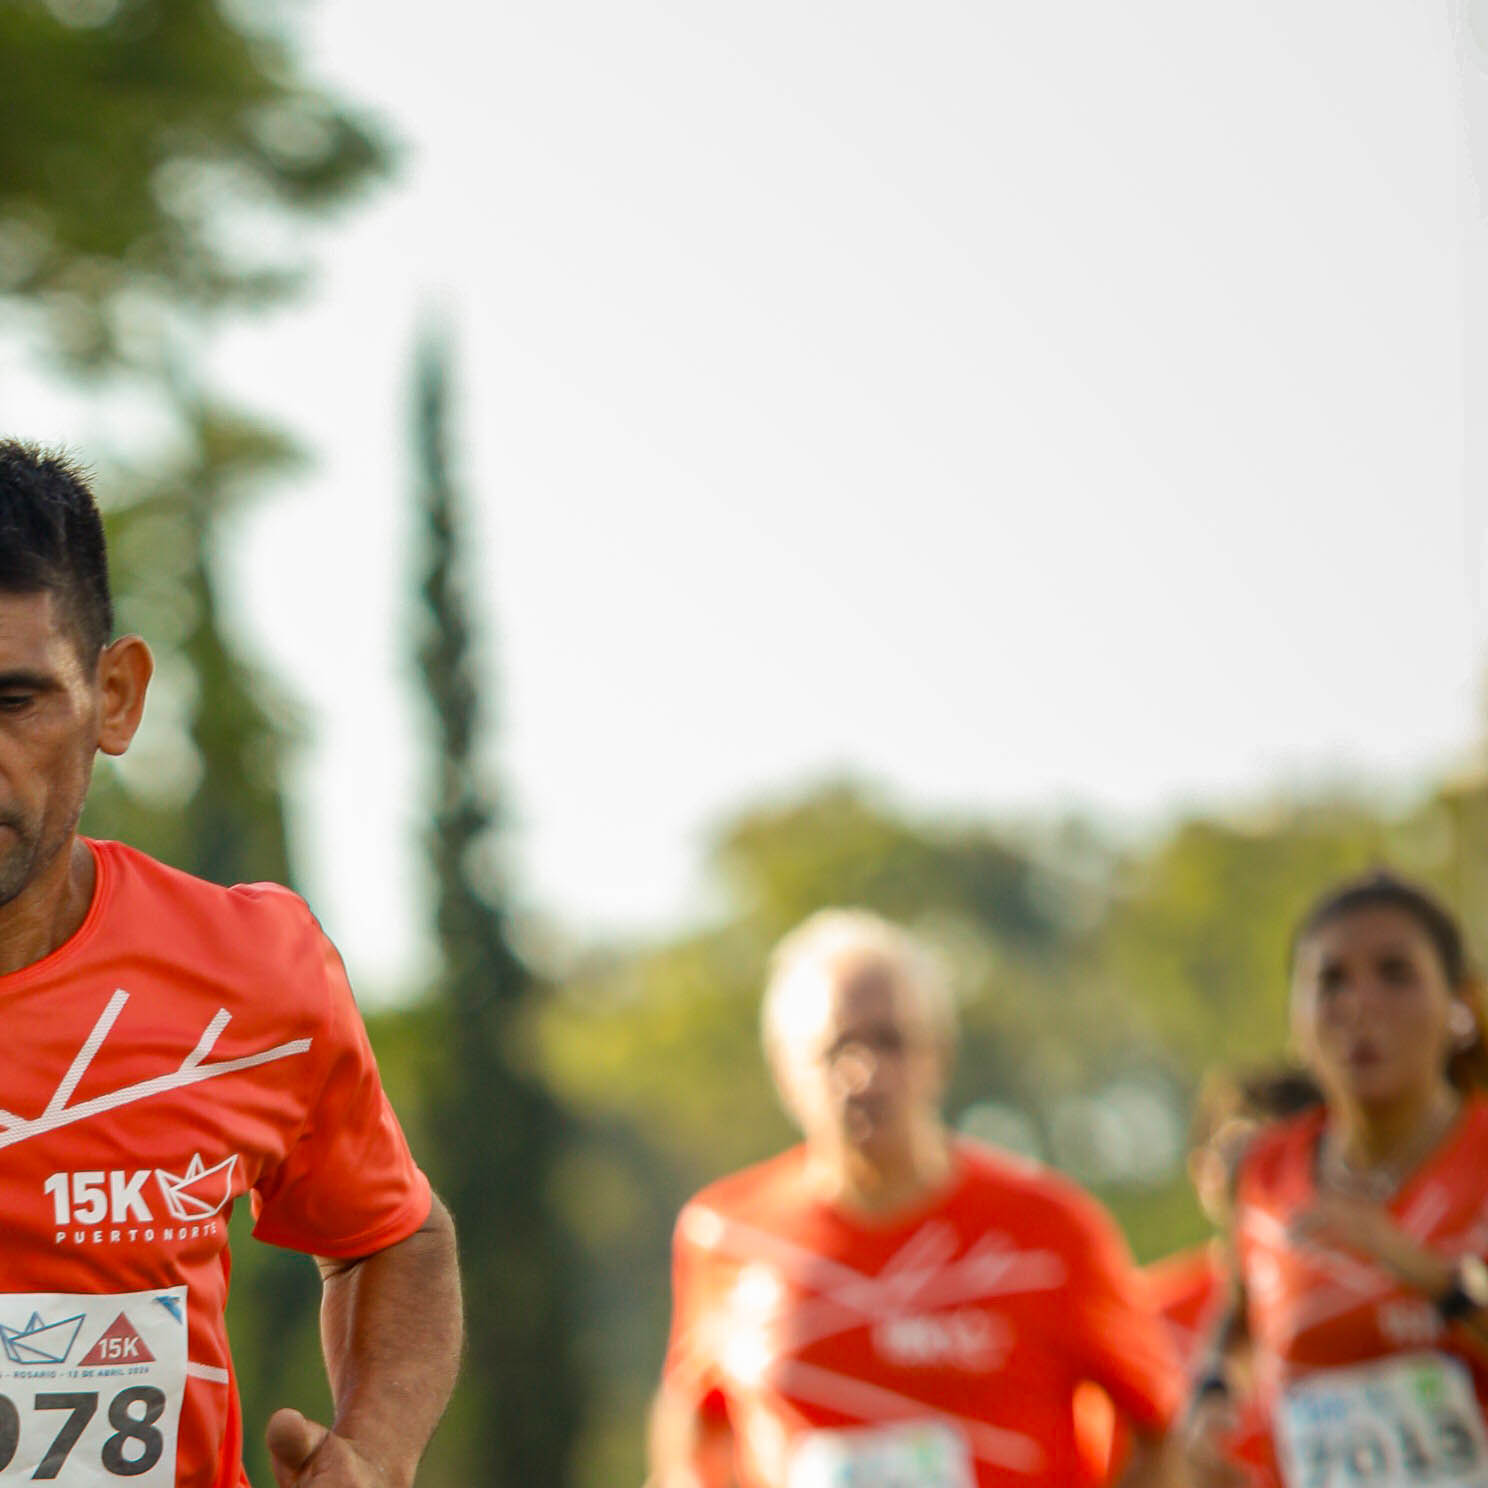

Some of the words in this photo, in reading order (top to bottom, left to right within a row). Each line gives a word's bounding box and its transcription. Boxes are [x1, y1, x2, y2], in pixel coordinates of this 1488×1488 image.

[44, 1169, 154, 1225] 15K
[55, 1228, 155, 1244] PUERTO
[163, 1221, 217, 1242] NORTE
[98, 1336, 141, 1360] 15K
